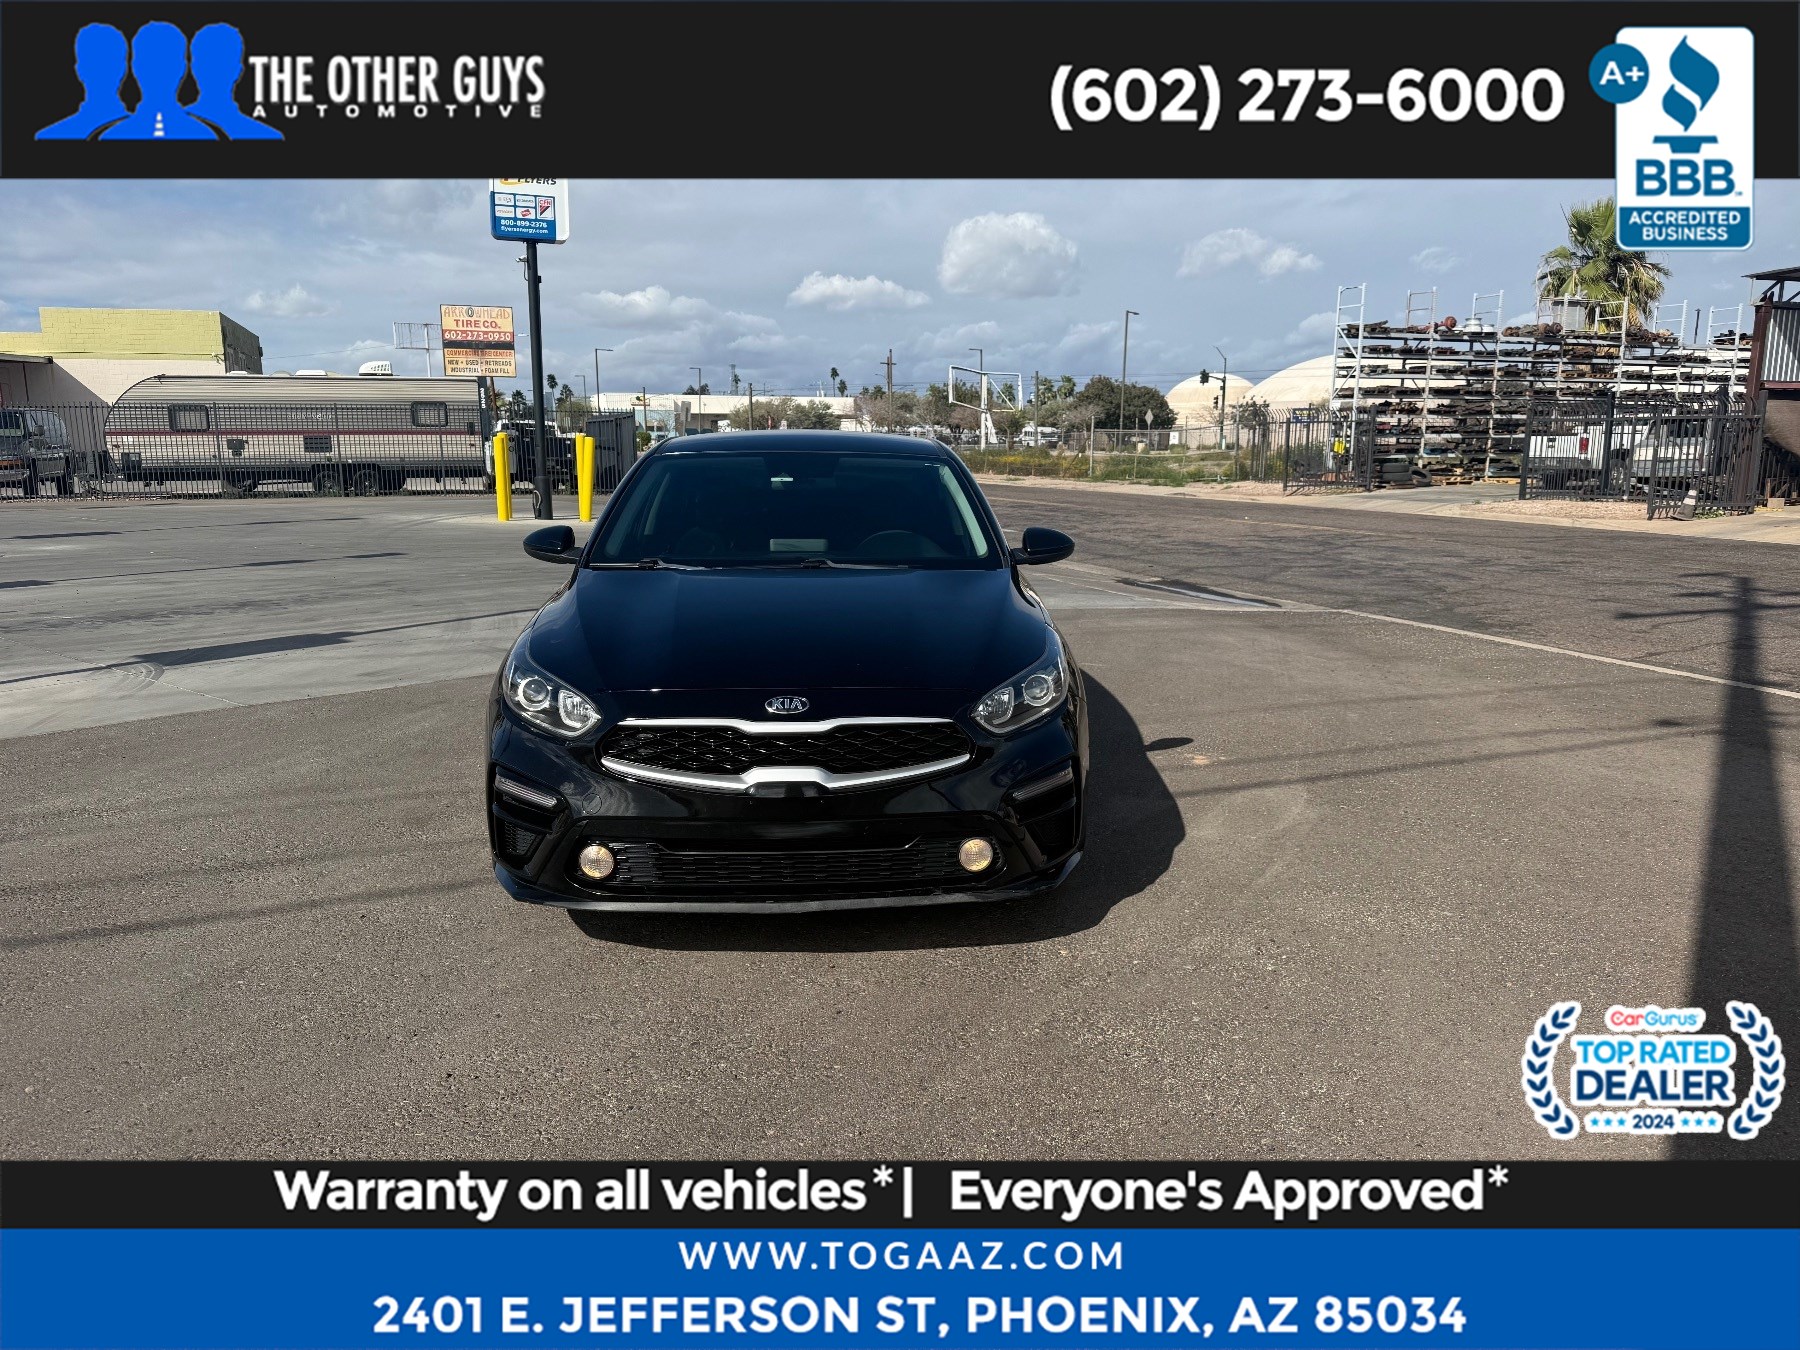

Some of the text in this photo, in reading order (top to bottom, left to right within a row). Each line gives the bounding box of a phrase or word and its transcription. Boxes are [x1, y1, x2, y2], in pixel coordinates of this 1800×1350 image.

[443, 306, 511, 320] ARROWHEAD
[453, 319, 502, 329] TIRE CO.
[444, 330, 511, 341] 602-273-0950
[771, 698, 803, 710] KIA
